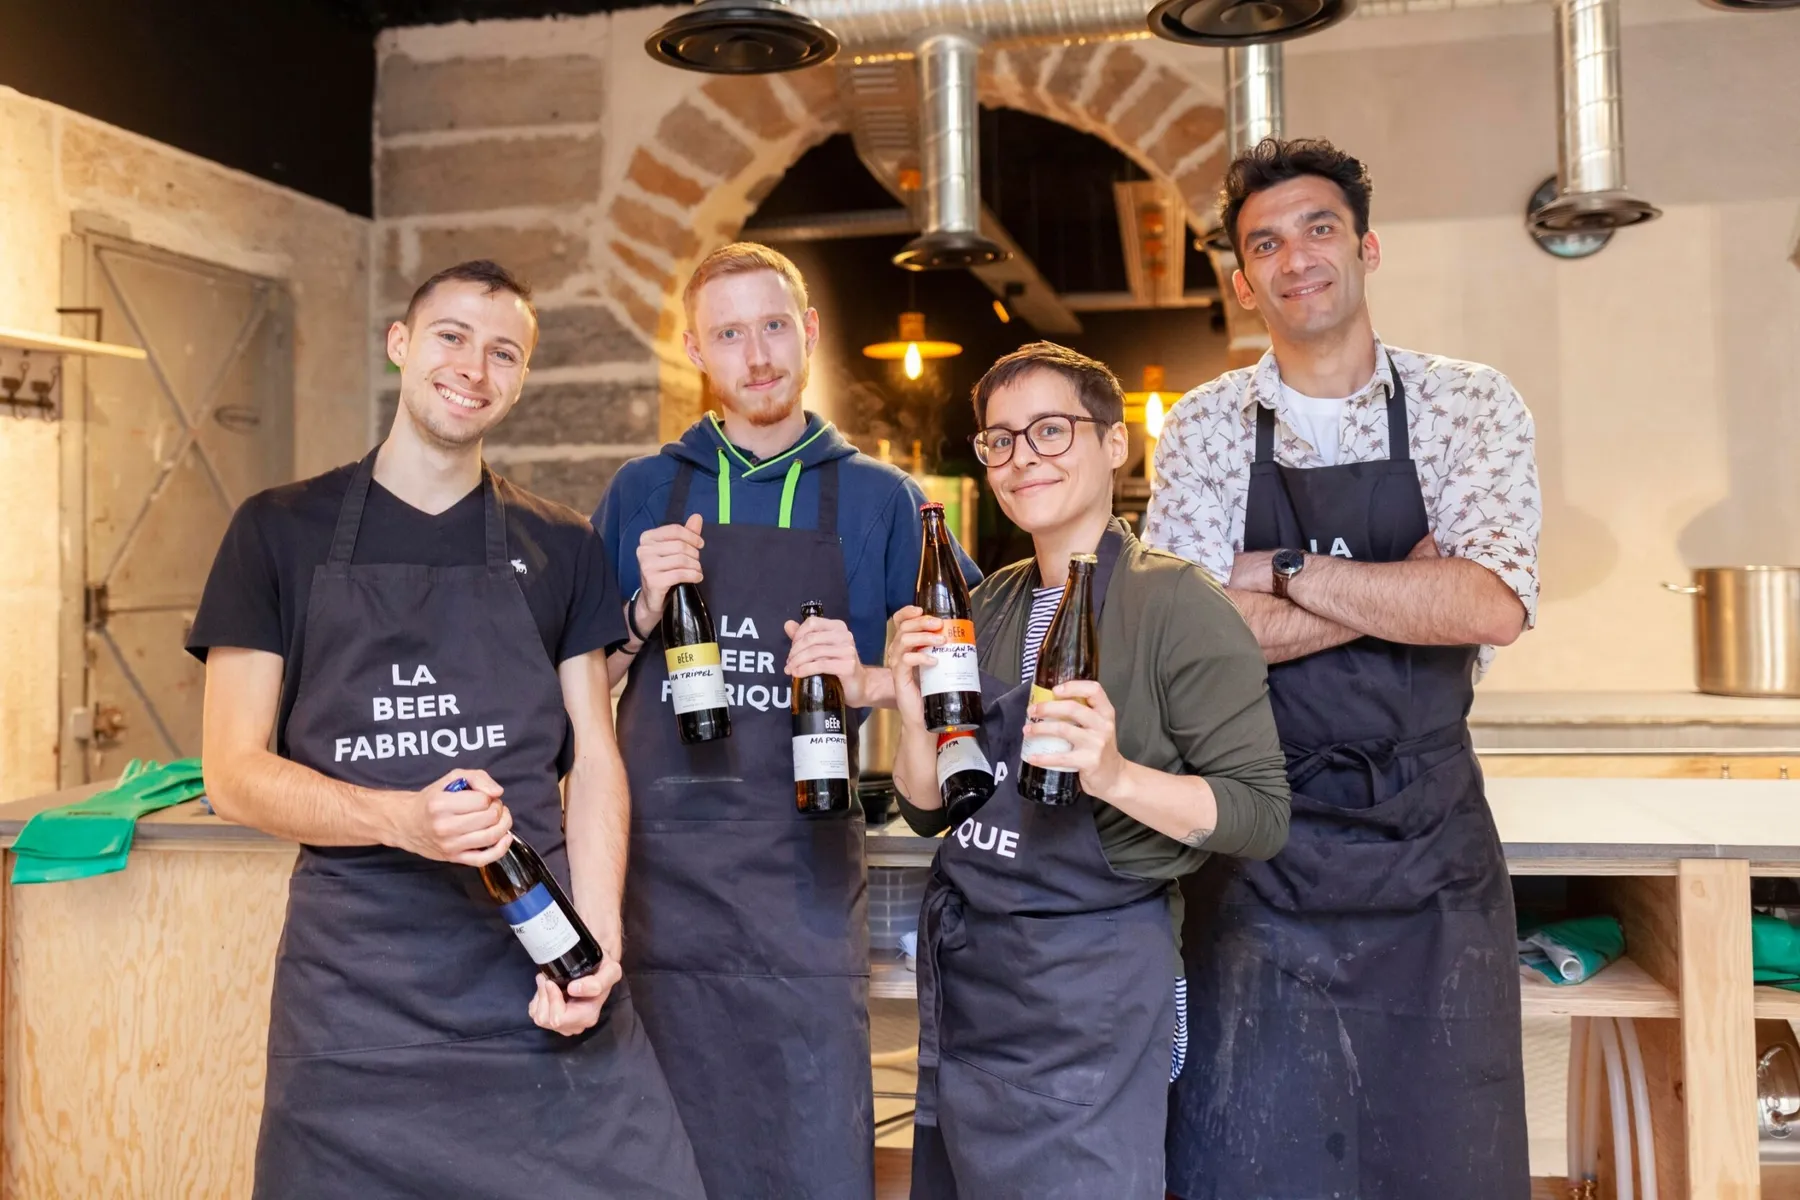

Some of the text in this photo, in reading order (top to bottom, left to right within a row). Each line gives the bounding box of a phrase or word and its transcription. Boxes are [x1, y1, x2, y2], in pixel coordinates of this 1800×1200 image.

[720, 615, 759, 639] LA
[948, 626, 966, 638] BEER
[677, 652, 694, 664] BEER
[721, 649, 775, 674] EER
[392, 664, 437, 686] LA
[373, 694, 460, 721] BEER
[825, 717, 841, 729] BEER
[334, 725, 507, 762] FABRIQUE
